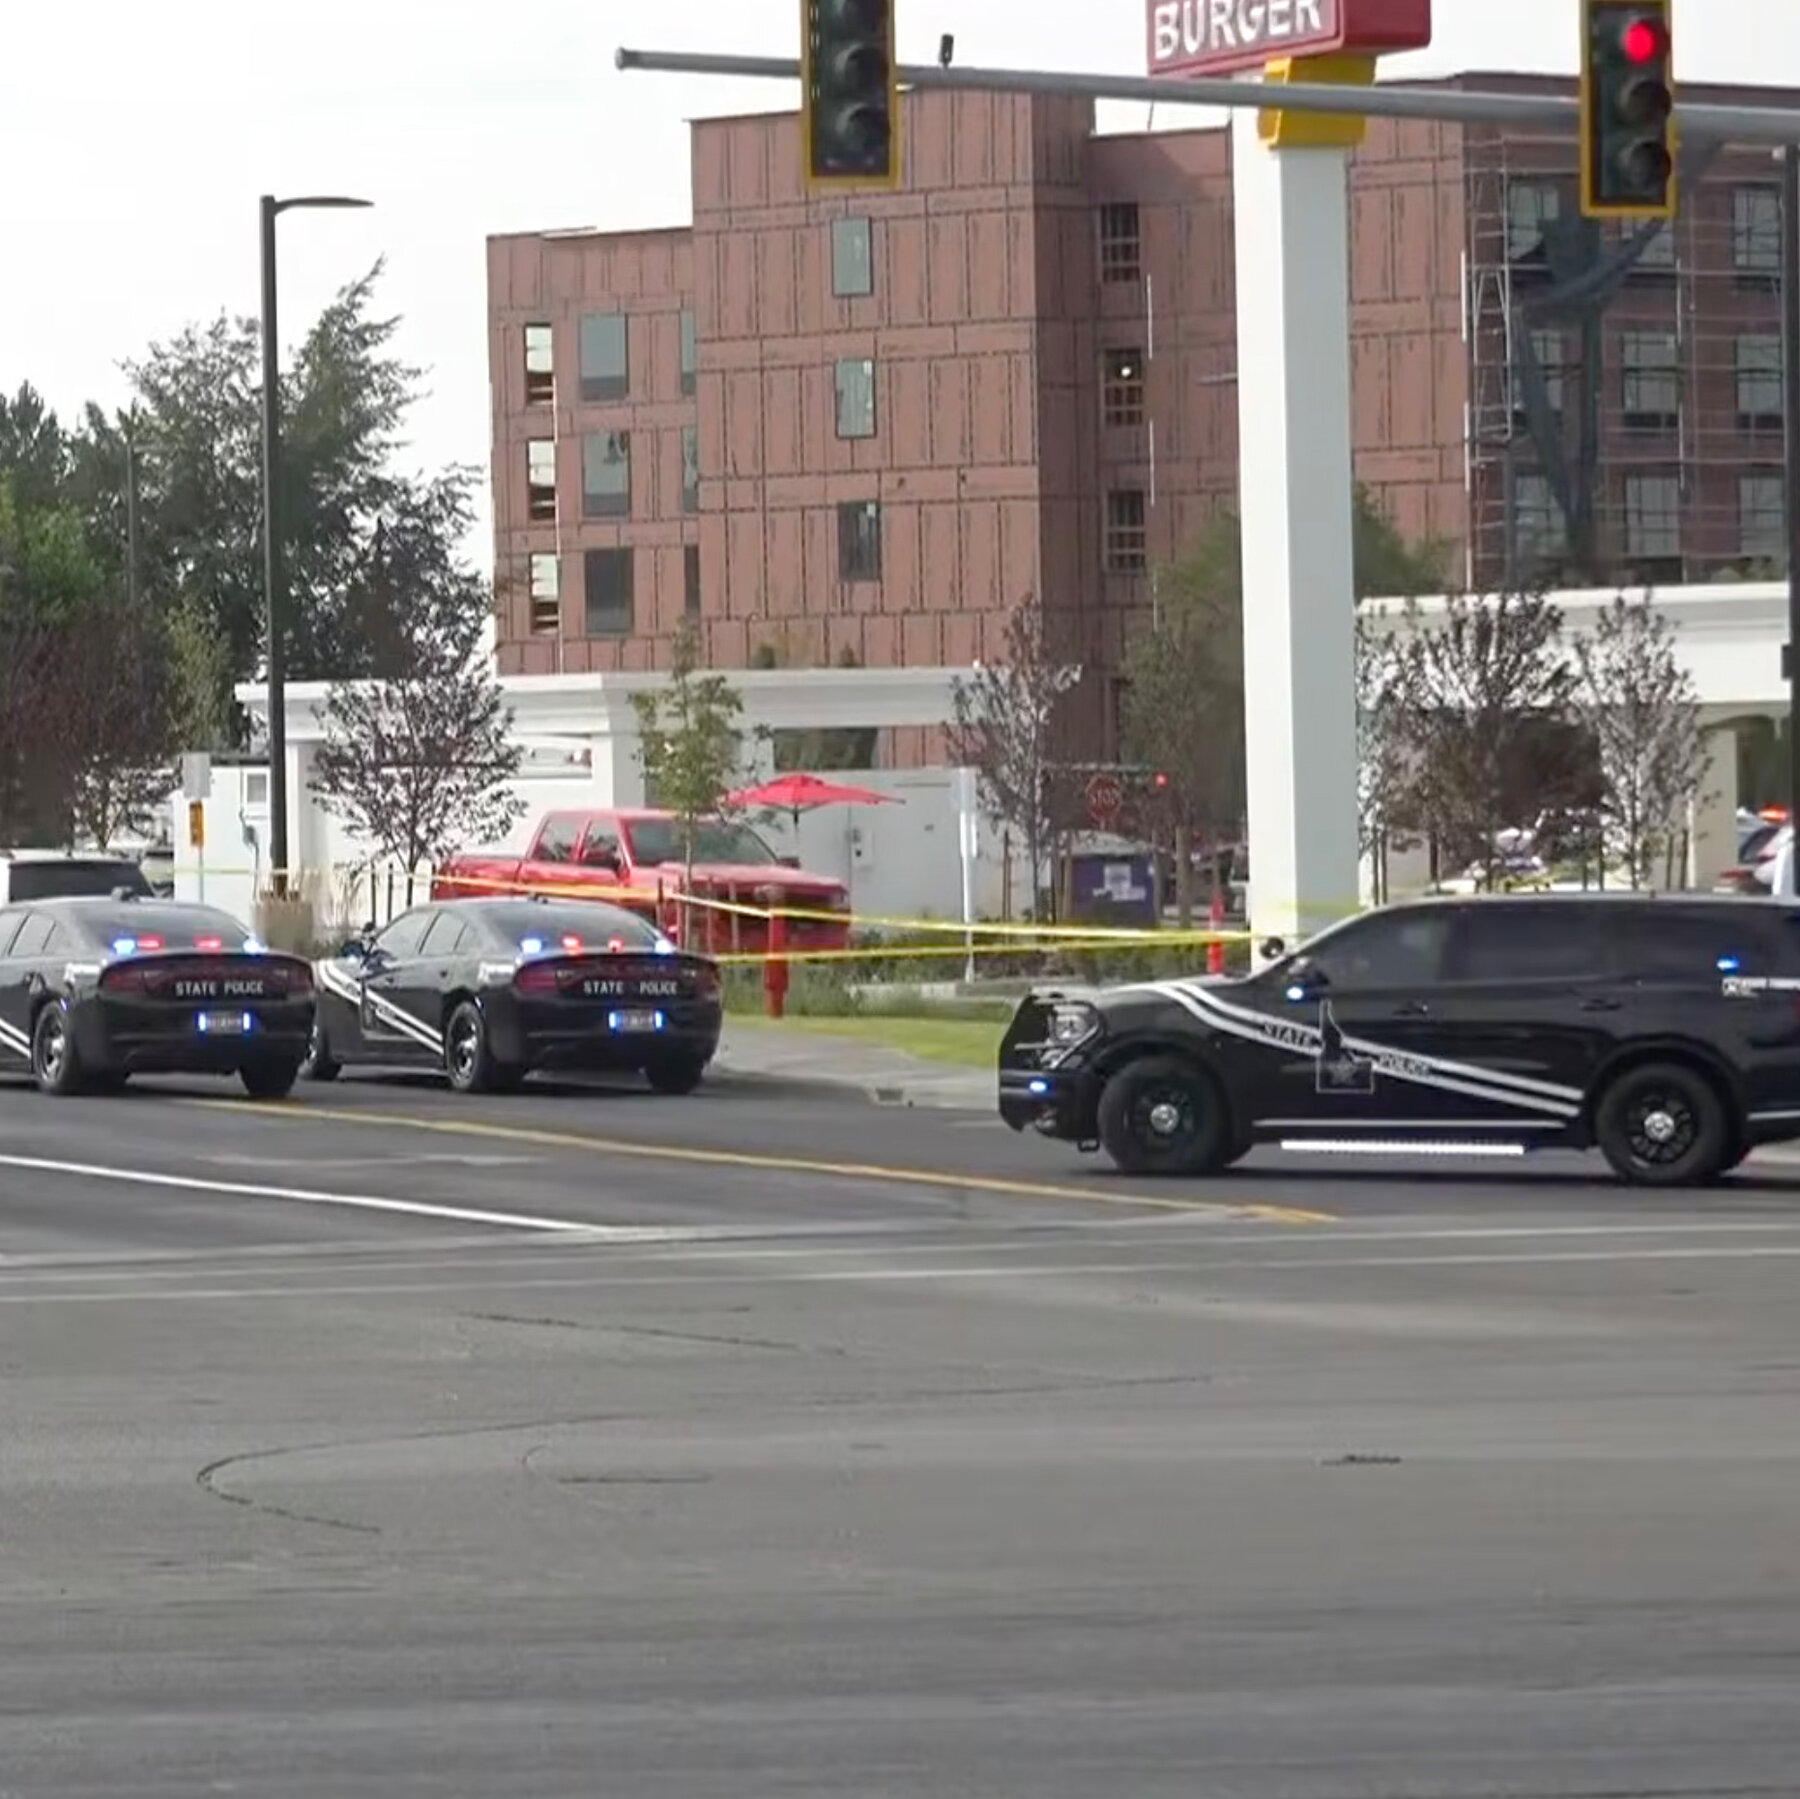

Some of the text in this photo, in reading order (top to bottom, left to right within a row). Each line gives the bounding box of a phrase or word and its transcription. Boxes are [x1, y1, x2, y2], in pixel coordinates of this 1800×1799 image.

[1154, 0, 1323, 60] BURGER
[175, 979, 264, 997] STATE POLICE
[583, 980, 678, 995] STATE POLICE
[1263, 1022, 1313, 1050] STATE
